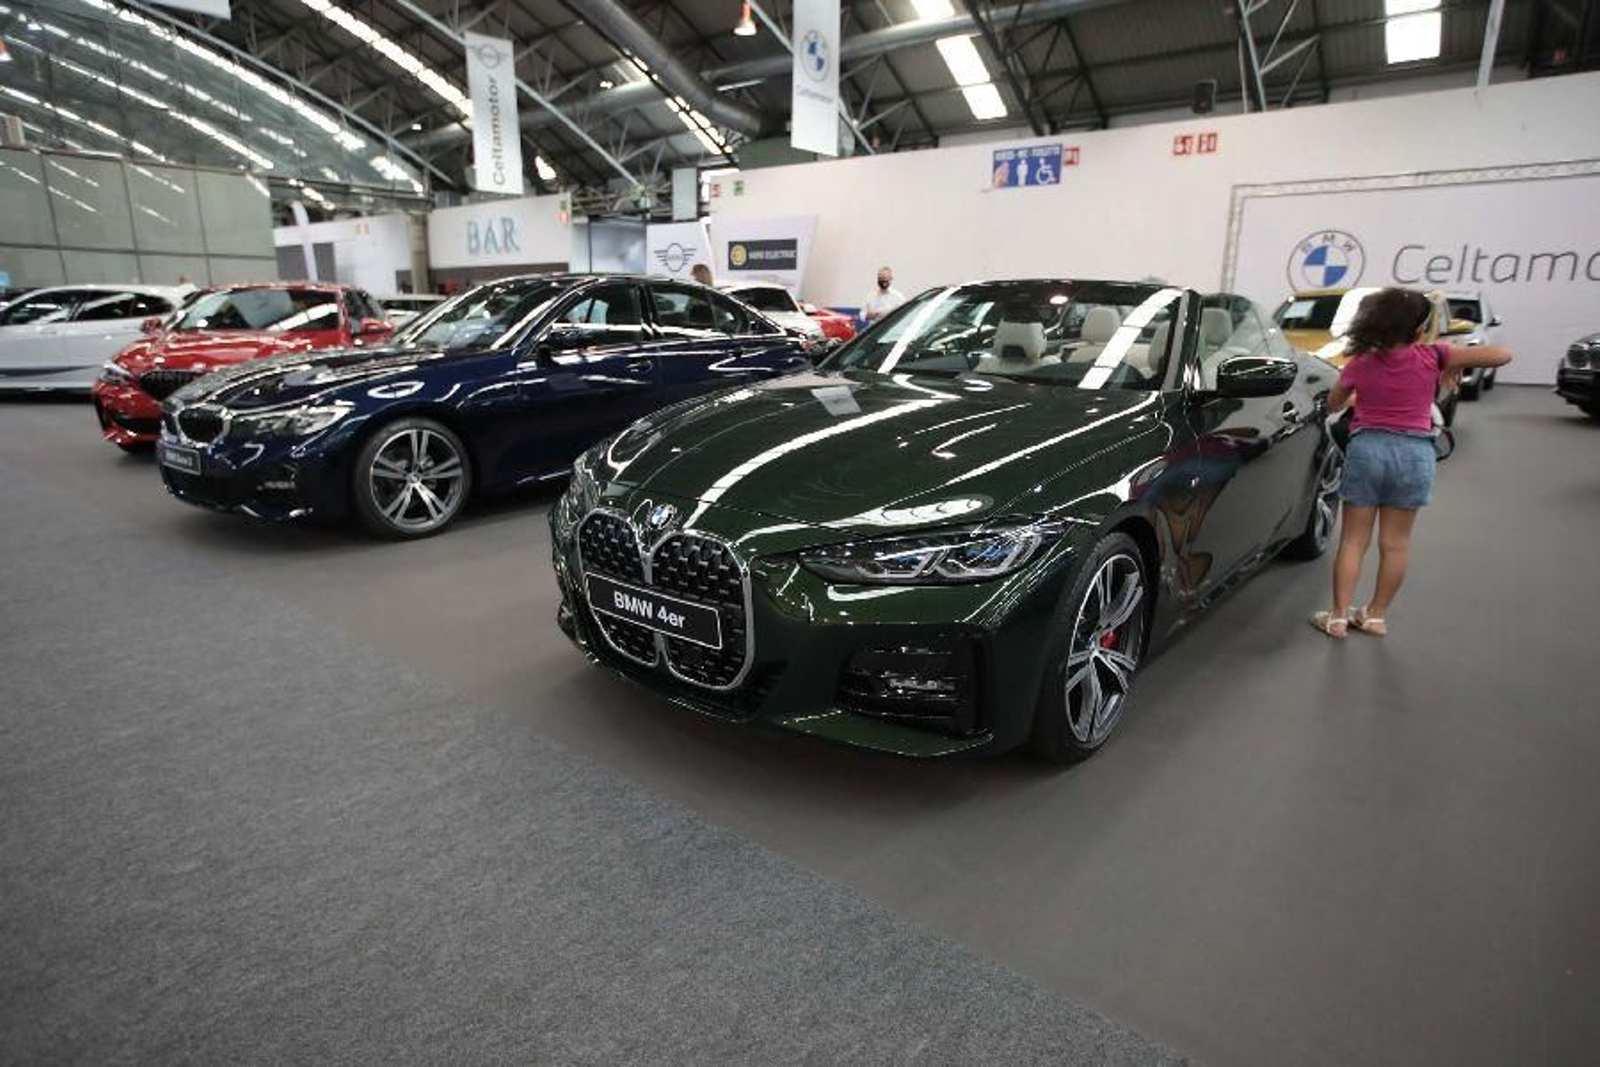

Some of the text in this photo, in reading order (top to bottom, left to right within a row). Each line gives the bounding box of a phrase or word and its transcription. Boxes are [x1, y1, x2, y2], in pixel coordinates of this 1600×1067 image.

[486, 74, 507, 186] Celtamotor
[467, 215, 521, 256] BAR
[613, 590, 686, 629] BMW 4er
